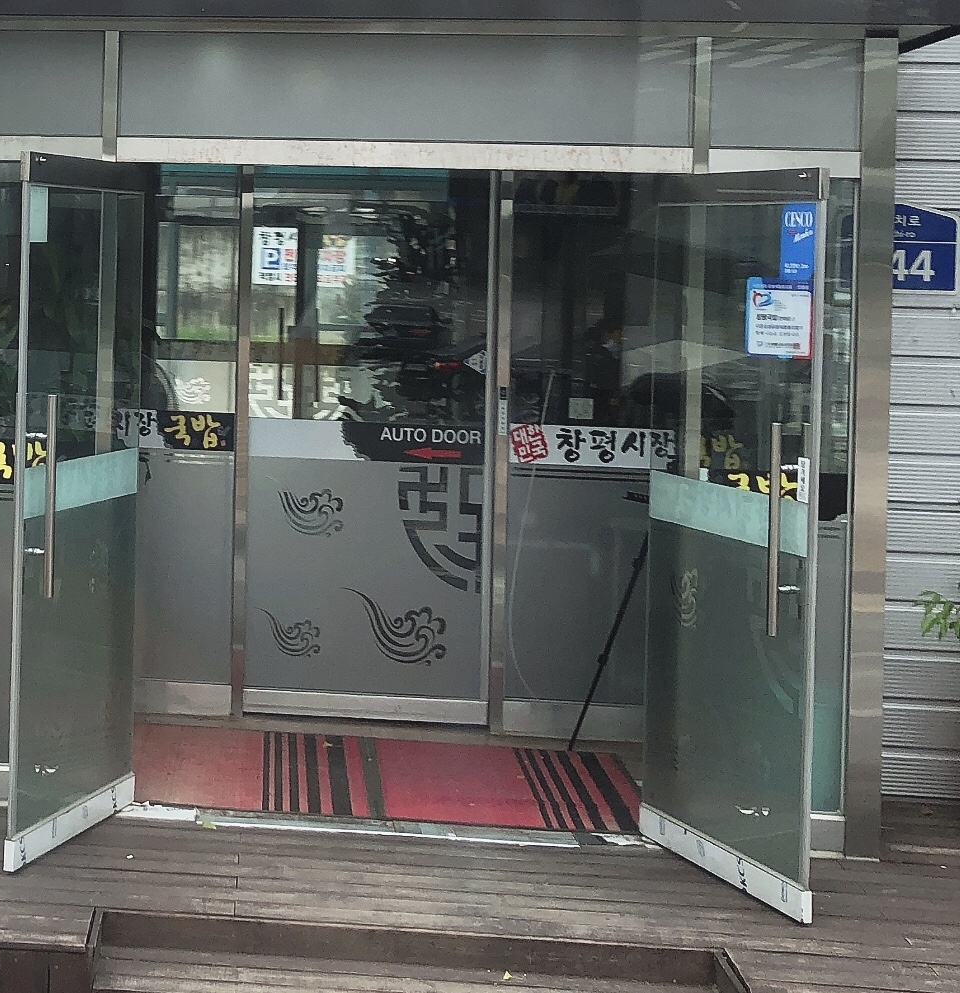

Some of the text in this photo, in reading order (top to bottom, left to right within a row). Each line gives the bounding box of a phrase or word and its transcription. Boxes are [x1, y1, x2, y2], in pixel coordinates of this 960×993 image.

[892, 249, 936, 282] 44
[163, 414, 222, 448] 국밥
[380, 427, 482, 444] AUTO DOOR
[556, 427, 674, 463] 창평시장
